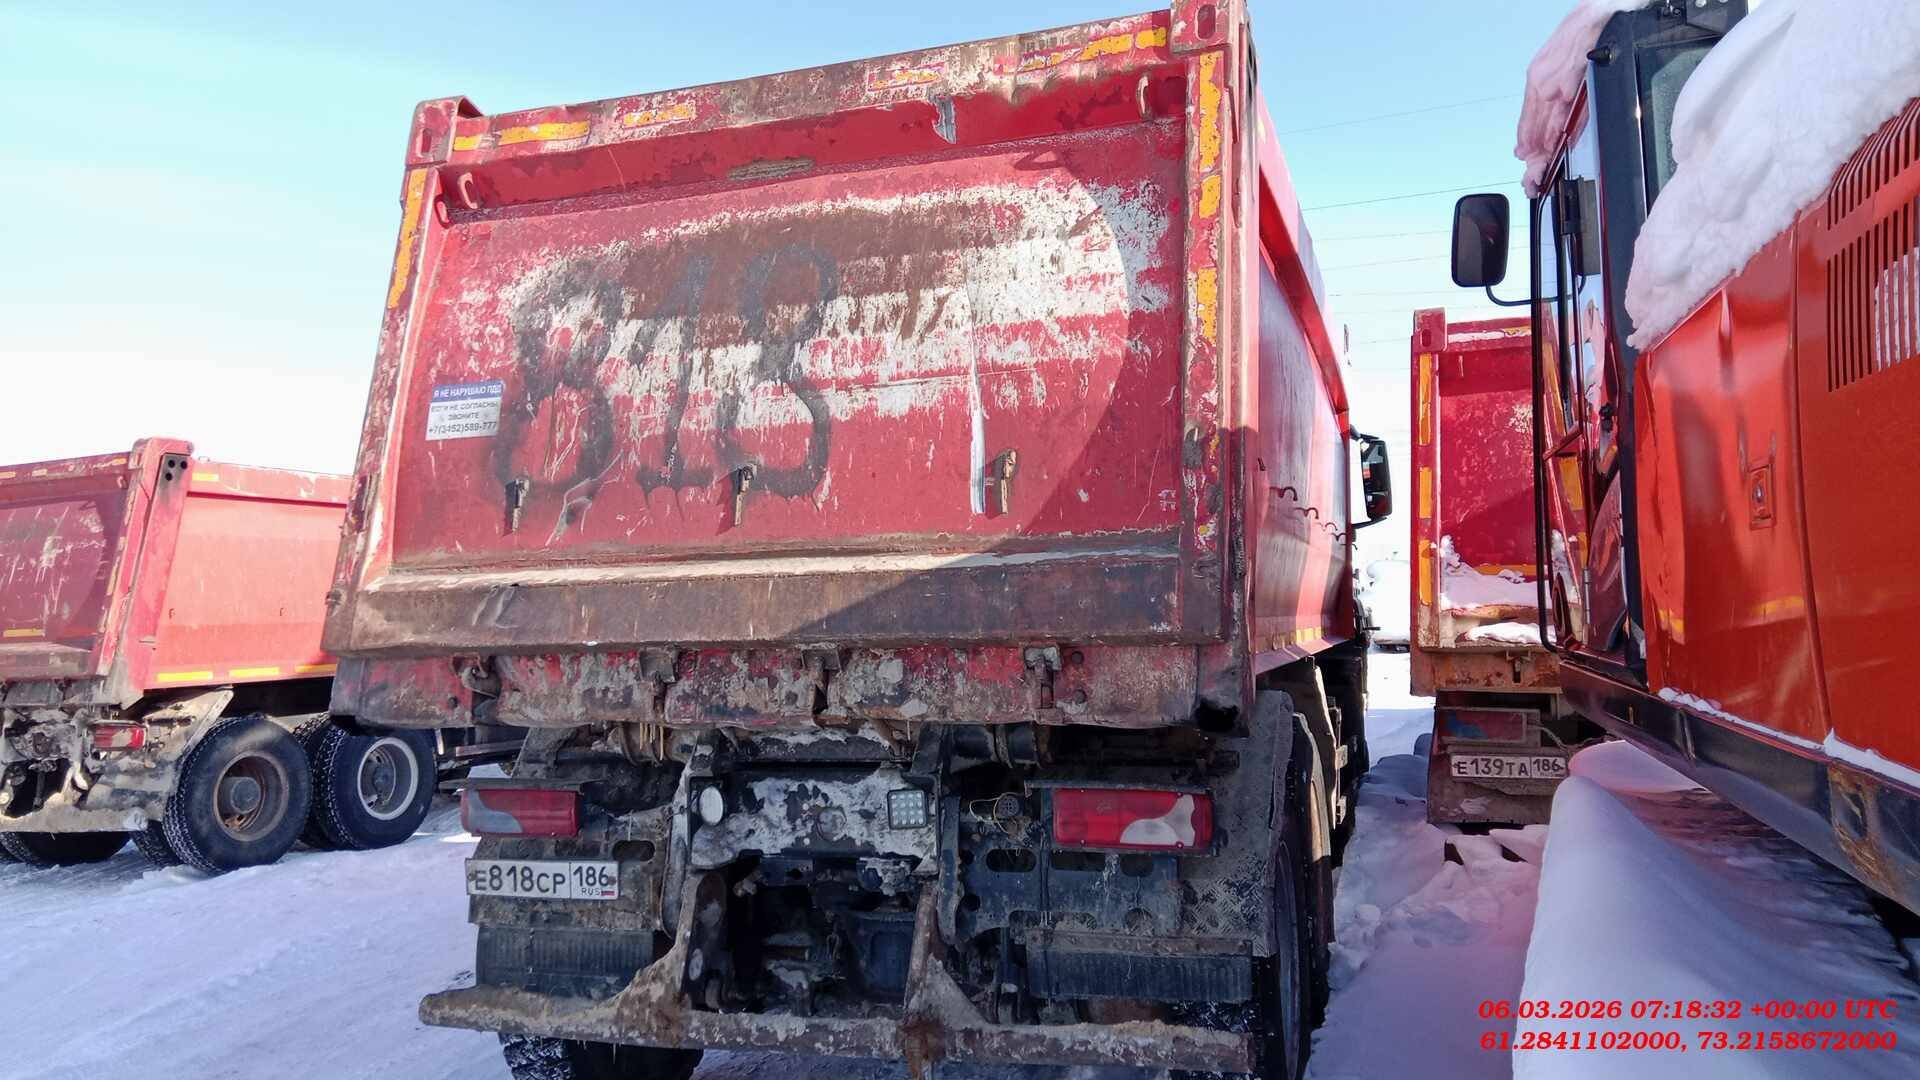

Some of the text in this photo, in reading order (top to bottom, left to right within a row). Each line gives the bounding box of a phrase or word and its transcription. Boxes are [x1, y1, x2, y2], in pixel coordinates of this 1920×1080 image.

[440, 388, 449, 398] НЕ
[450, 386, 486, 397] НАРУШАЮ
[1456, 758, 1560, 776] Е139ТА 186
[474, 865, 609, 894] Е818СР 186
[582, 888, 600, 896] RUS
